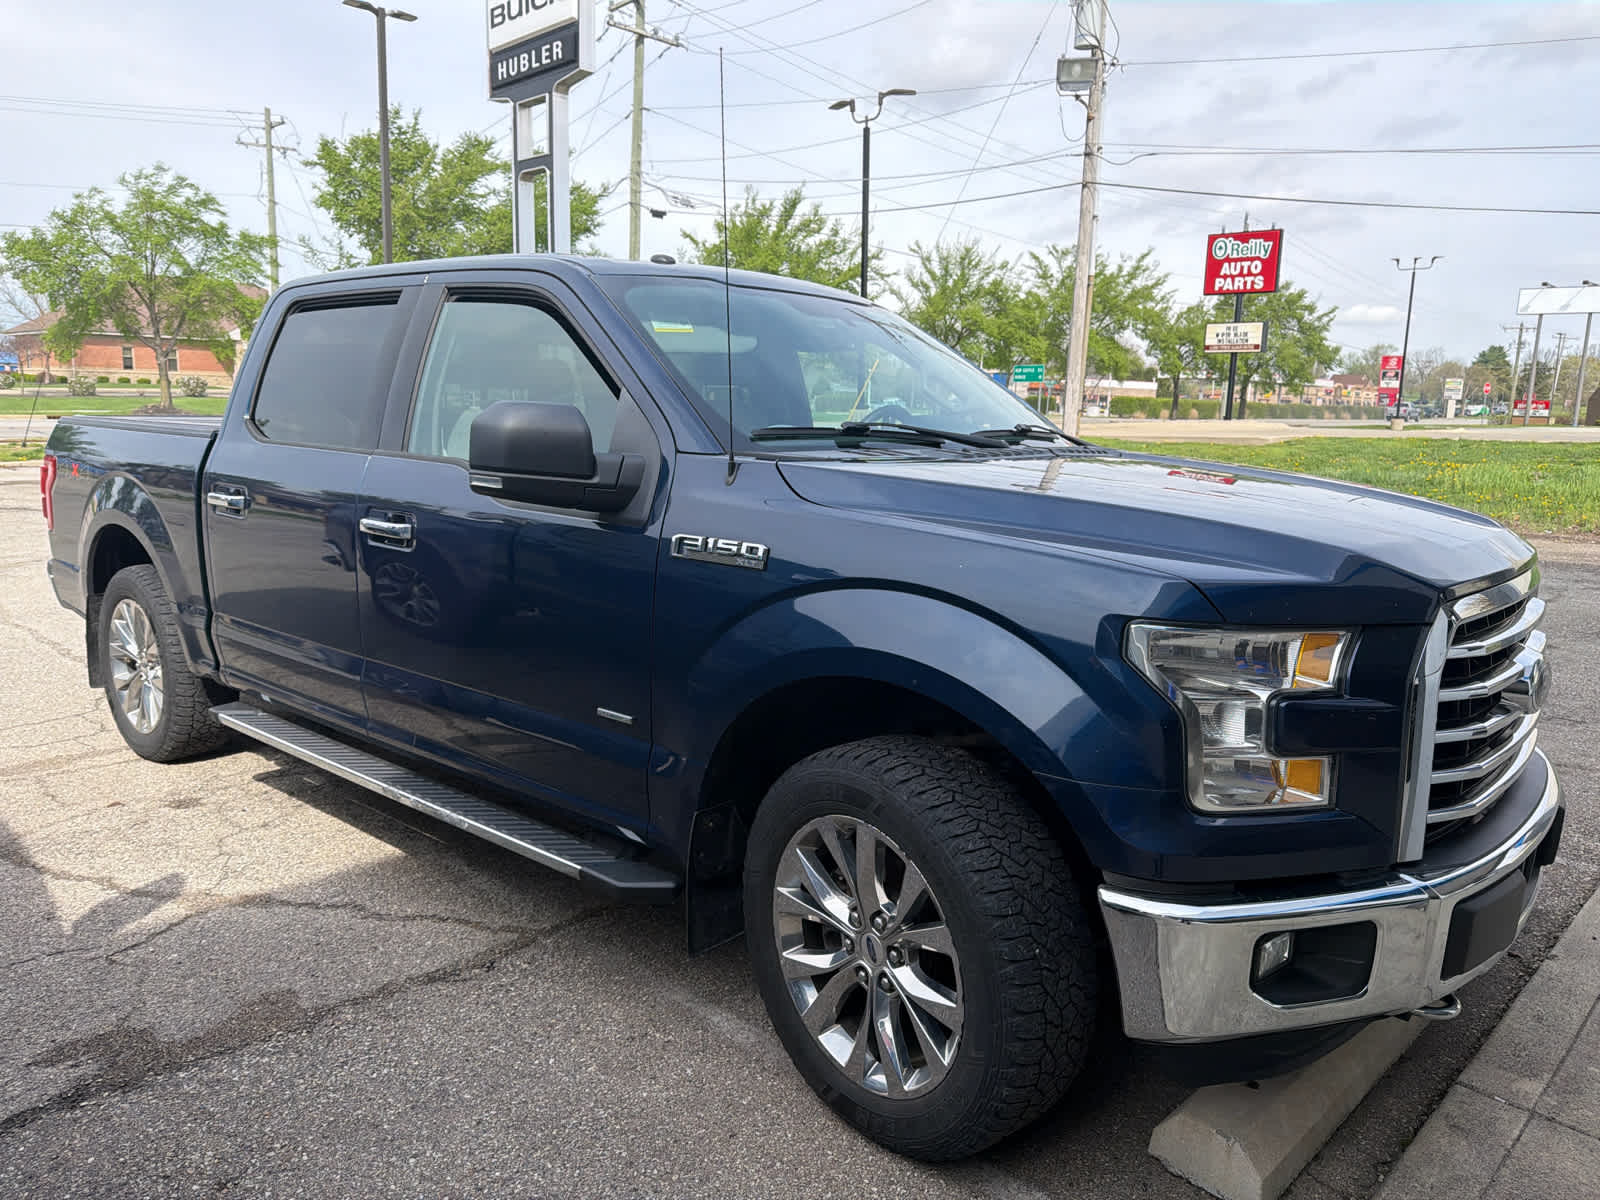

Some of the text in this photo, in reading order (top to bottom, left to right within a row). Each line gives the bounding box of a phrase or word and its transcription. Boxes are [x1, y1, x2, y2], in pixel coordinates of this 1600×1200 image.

[490, 0, 557, 29] BUIC
[497, 41, 563, 80] HUBLER
[1212, 237, 1274, 260] O'Reilly
[1220, 260, 1262, 276] AUTO
[1214, 275, 1265, 292] PARTS
